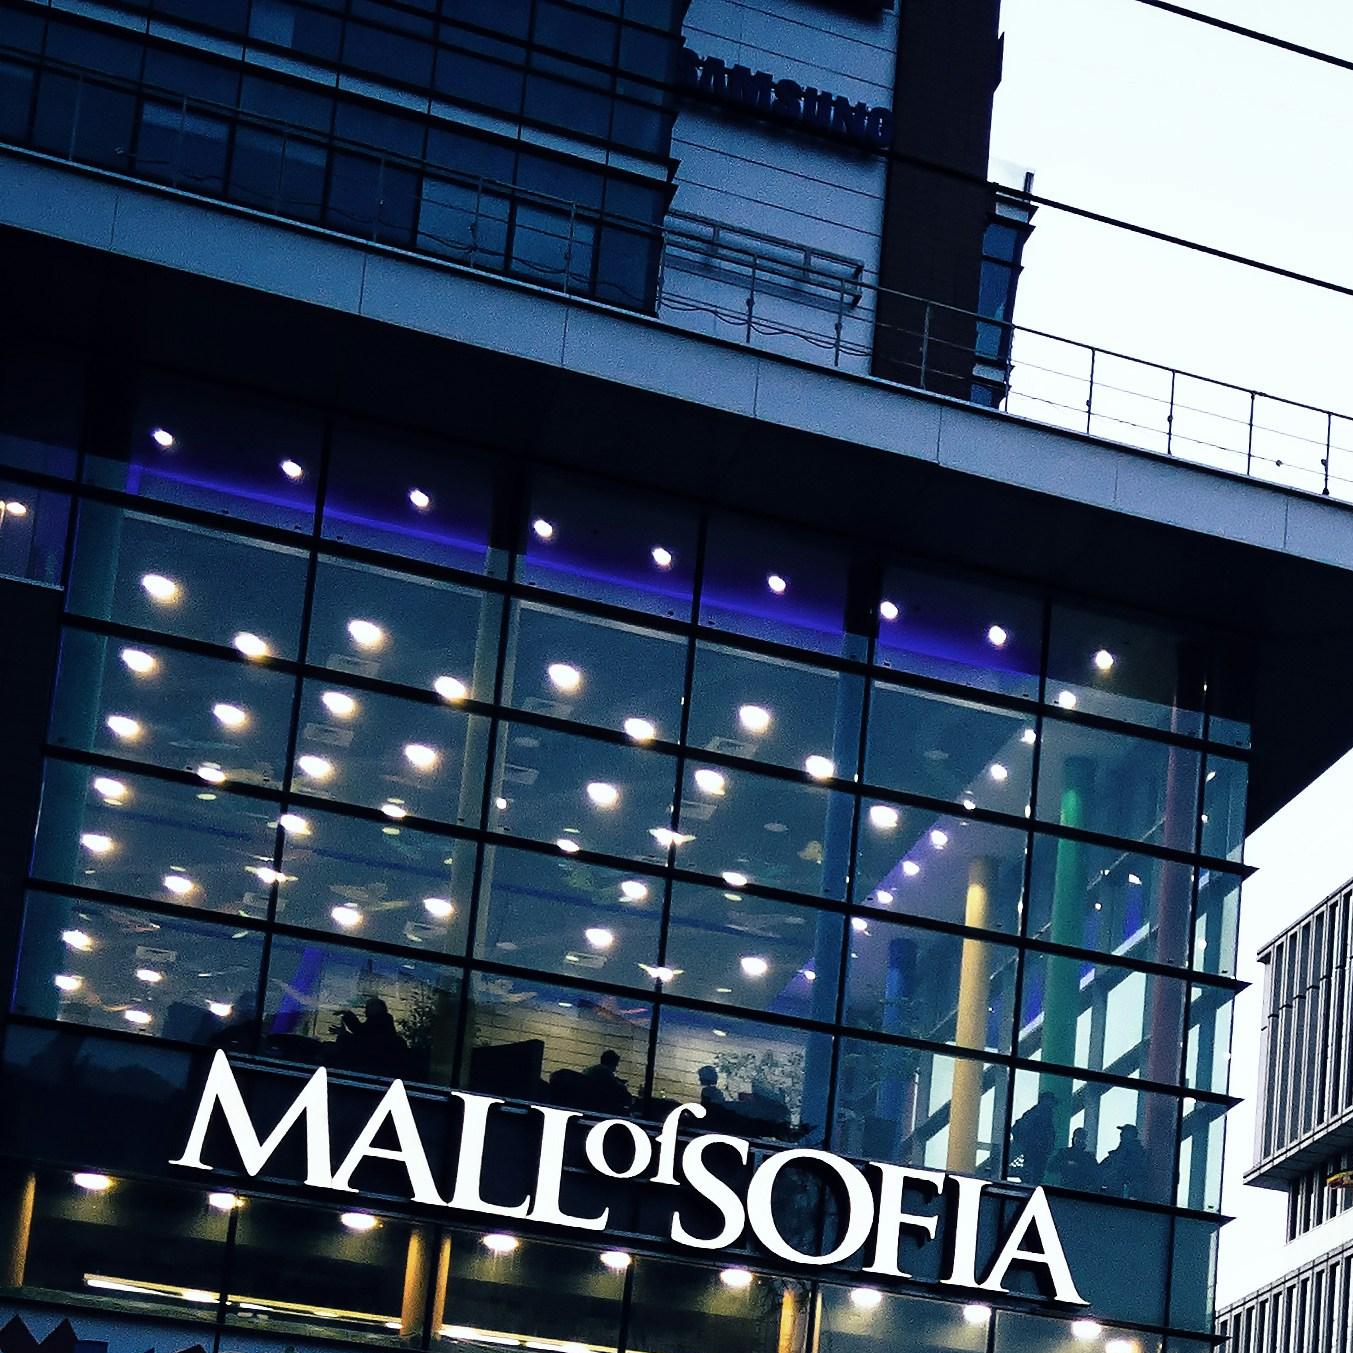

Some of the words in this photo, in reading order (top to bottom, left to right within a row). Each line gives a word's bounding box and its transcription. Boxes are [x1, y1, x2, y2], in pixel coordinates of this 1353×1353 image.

[674, 47, 893, 143] SAMSUNG
[168, 1048, 609, 1231] MALL
[585, 1102, 706, 1186] of
[671, 1133, 1090, 1306] SOFIA
